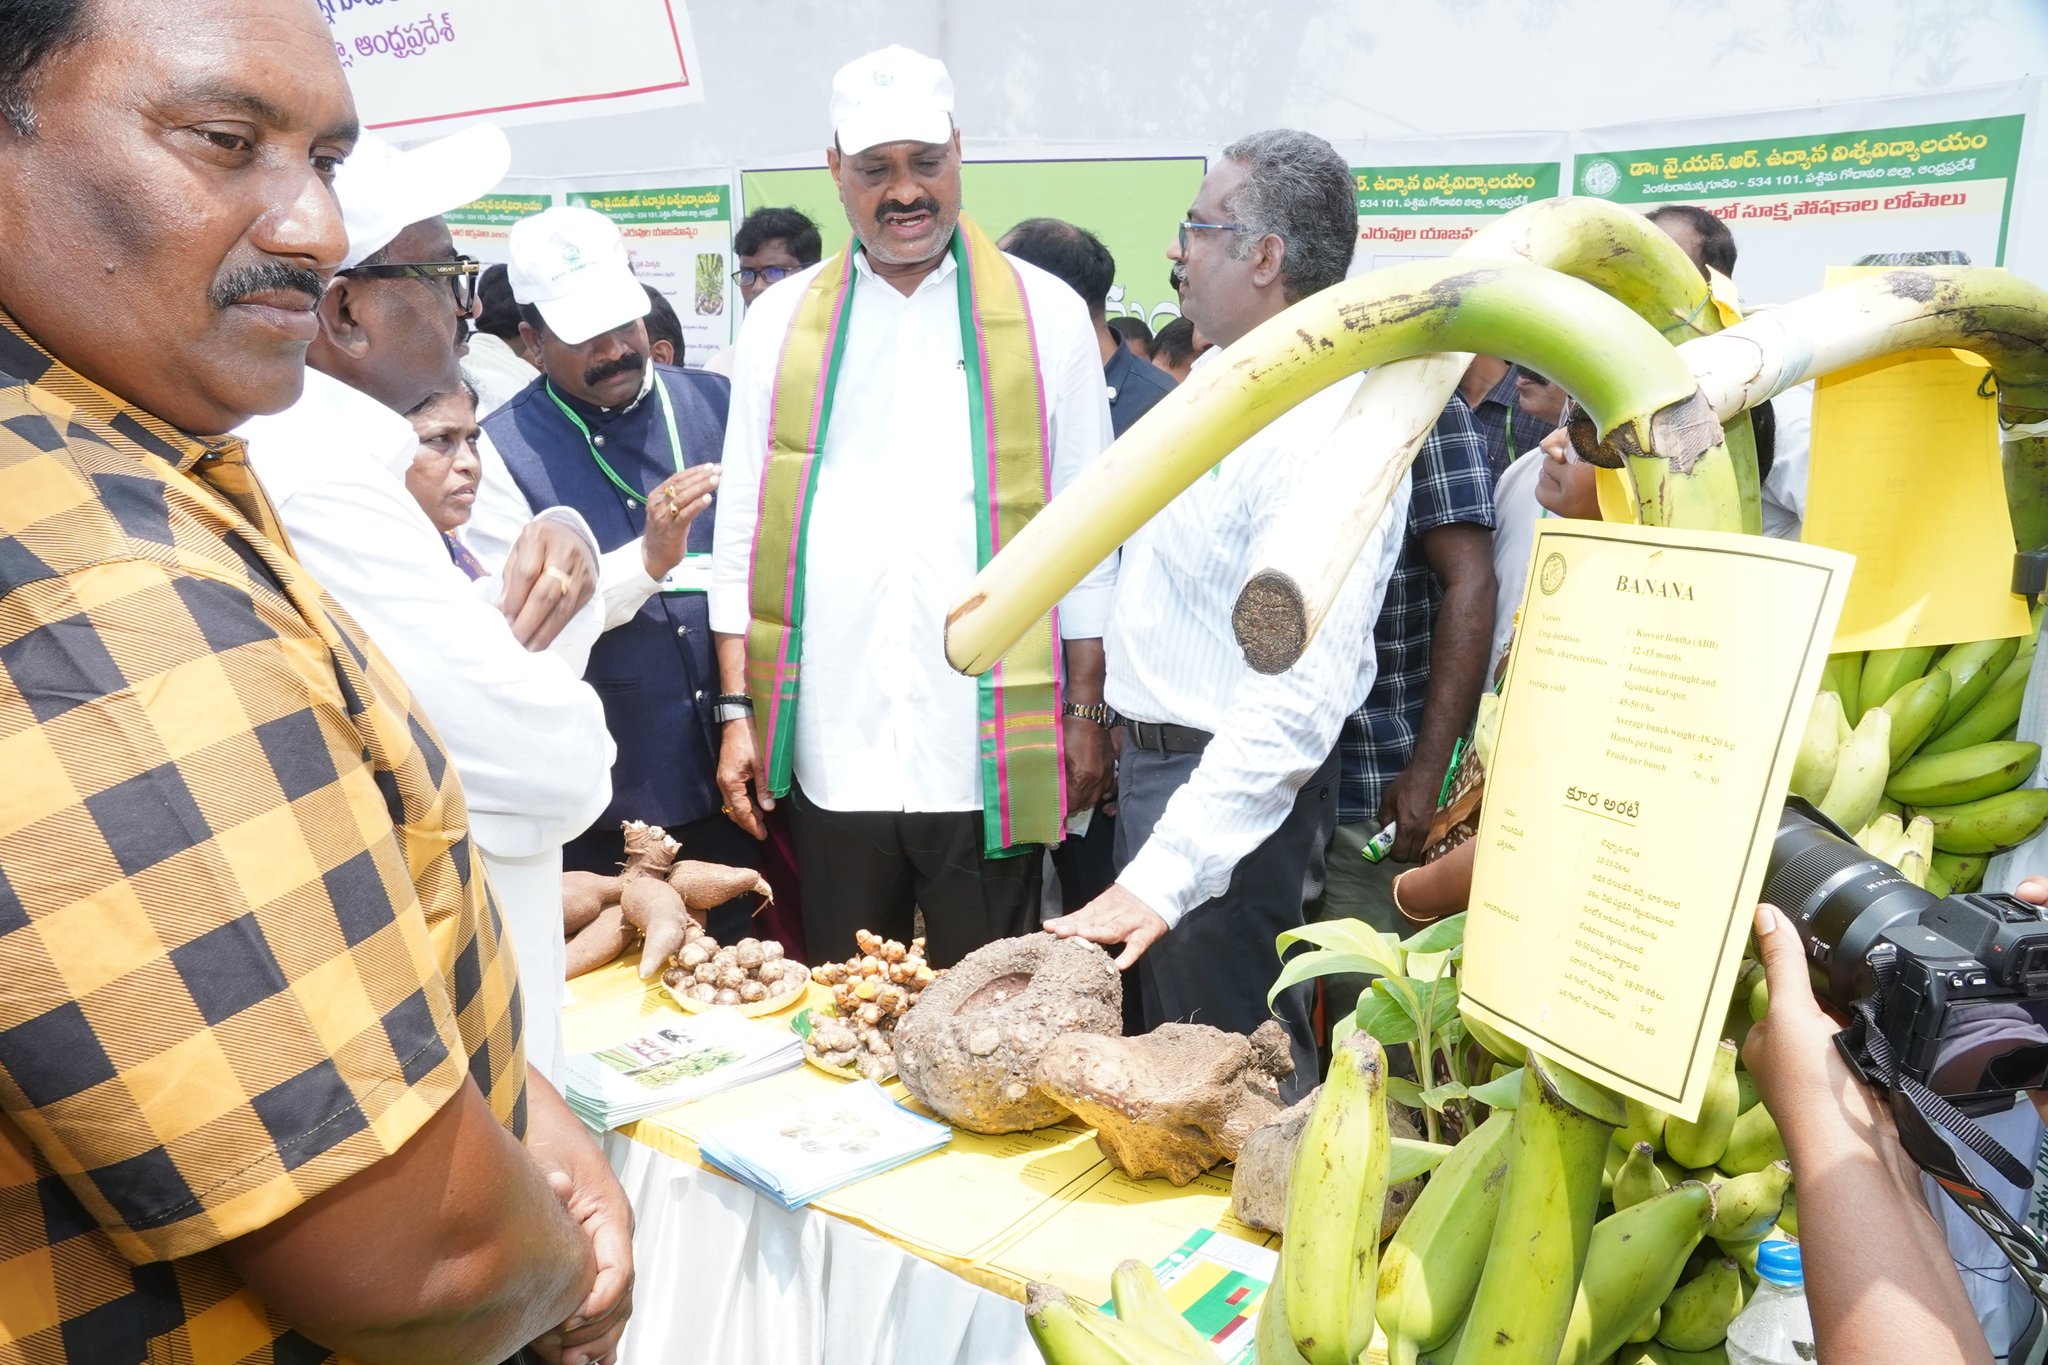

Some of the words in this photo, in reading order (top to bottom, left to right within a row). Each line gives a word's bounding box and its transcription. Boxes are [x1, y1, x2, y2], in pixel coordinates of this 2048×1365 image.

[355, 12, 455, 59] ఆంధ్రప్రదేశ్
[1765, 143, 1828, 171] ఉద్యాన
[1831, 131, 1988, 166] విశ్వవిద్యాలయం
[1373, 174, 1420, 196] ఉద్యాన
[1422, 172, 1536, 196] విశ్వవిద్యాలయం
[1747, 177, 1772, 188] 534
[1360, 200, 1379, 208] 534
[1883, 190, 1967, 212] లోపాలు
[1616, 574, 1694, 602] BANANA
[1655, 651, 1682, 663] months
[1628, 663, 1660, 677] Tolerant
[1669, 671, 1699, 685] drought
[1700, 677, 1717, 688] and
[1565, 785, 1599, 807] కూర
[1603, 797, 1641, 819] అరటి
